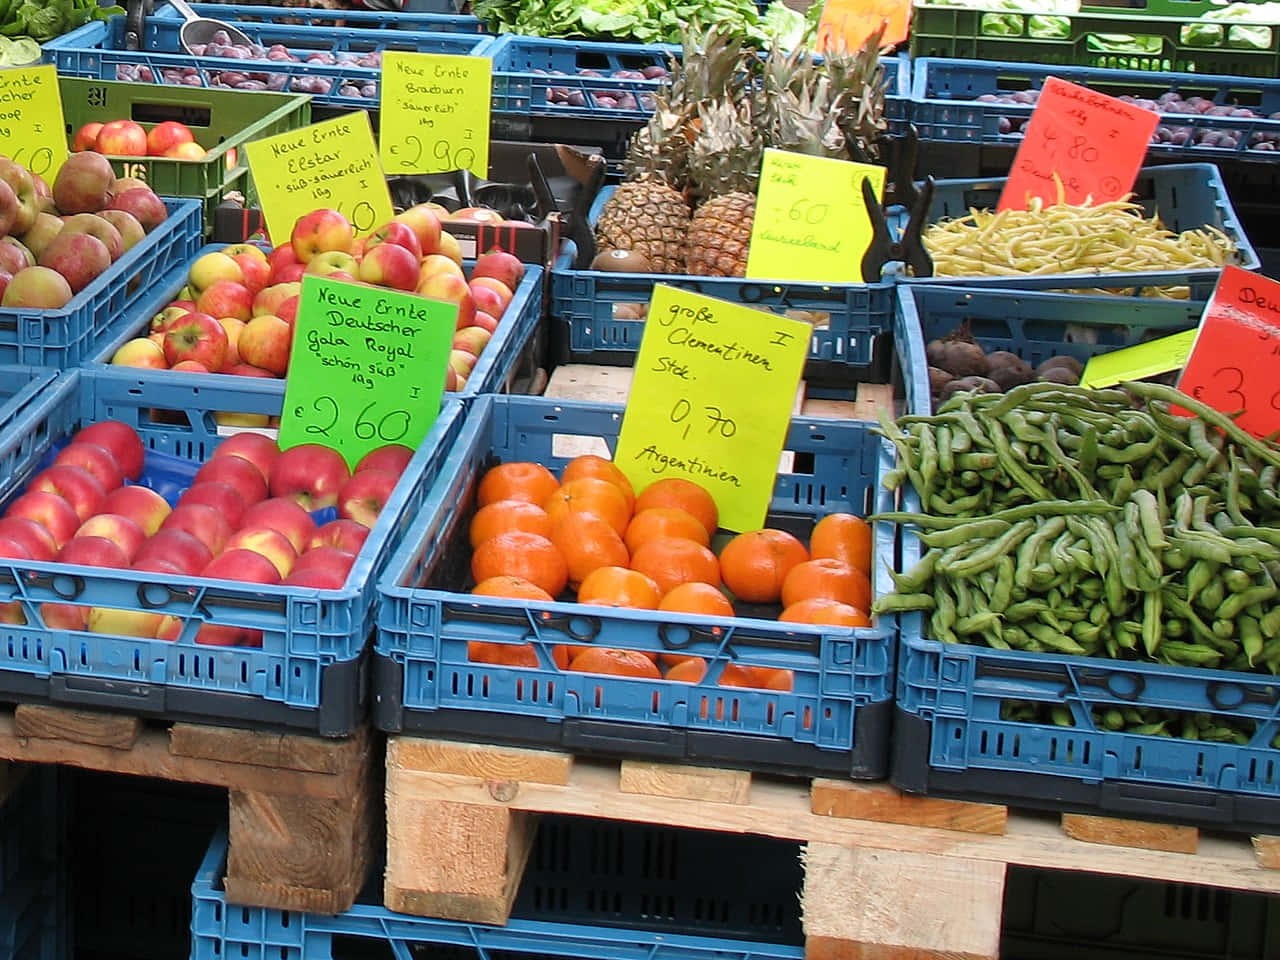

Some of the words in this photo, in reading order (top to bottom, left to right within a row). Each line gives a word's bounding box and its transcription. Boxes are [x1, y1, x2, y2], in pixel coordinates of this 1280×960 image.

[396, 60, 425, 76] Neue
[434, 65, 469, 79] Ernte
[406, 82, 465, 95] Braeburn
[271, 139, 306, 158] Neue
[312, 124, 351, 144] Ernte
[287, 150, 341, 174] Elstar
[318, 287, 361, 309] Neue
[375, 299, 427, 322] Ernte
[659, 303, 718, 327] große
[326, 310, 422, 338] Deutscher
[307, 330, 349, 352] Gala
[365, 337, 414, 362] Royal
[667, 327, 773, 372] Clementinen
[670, 399, 737, 440] 0,70
[635, 444, 741, 489] Argentinien
